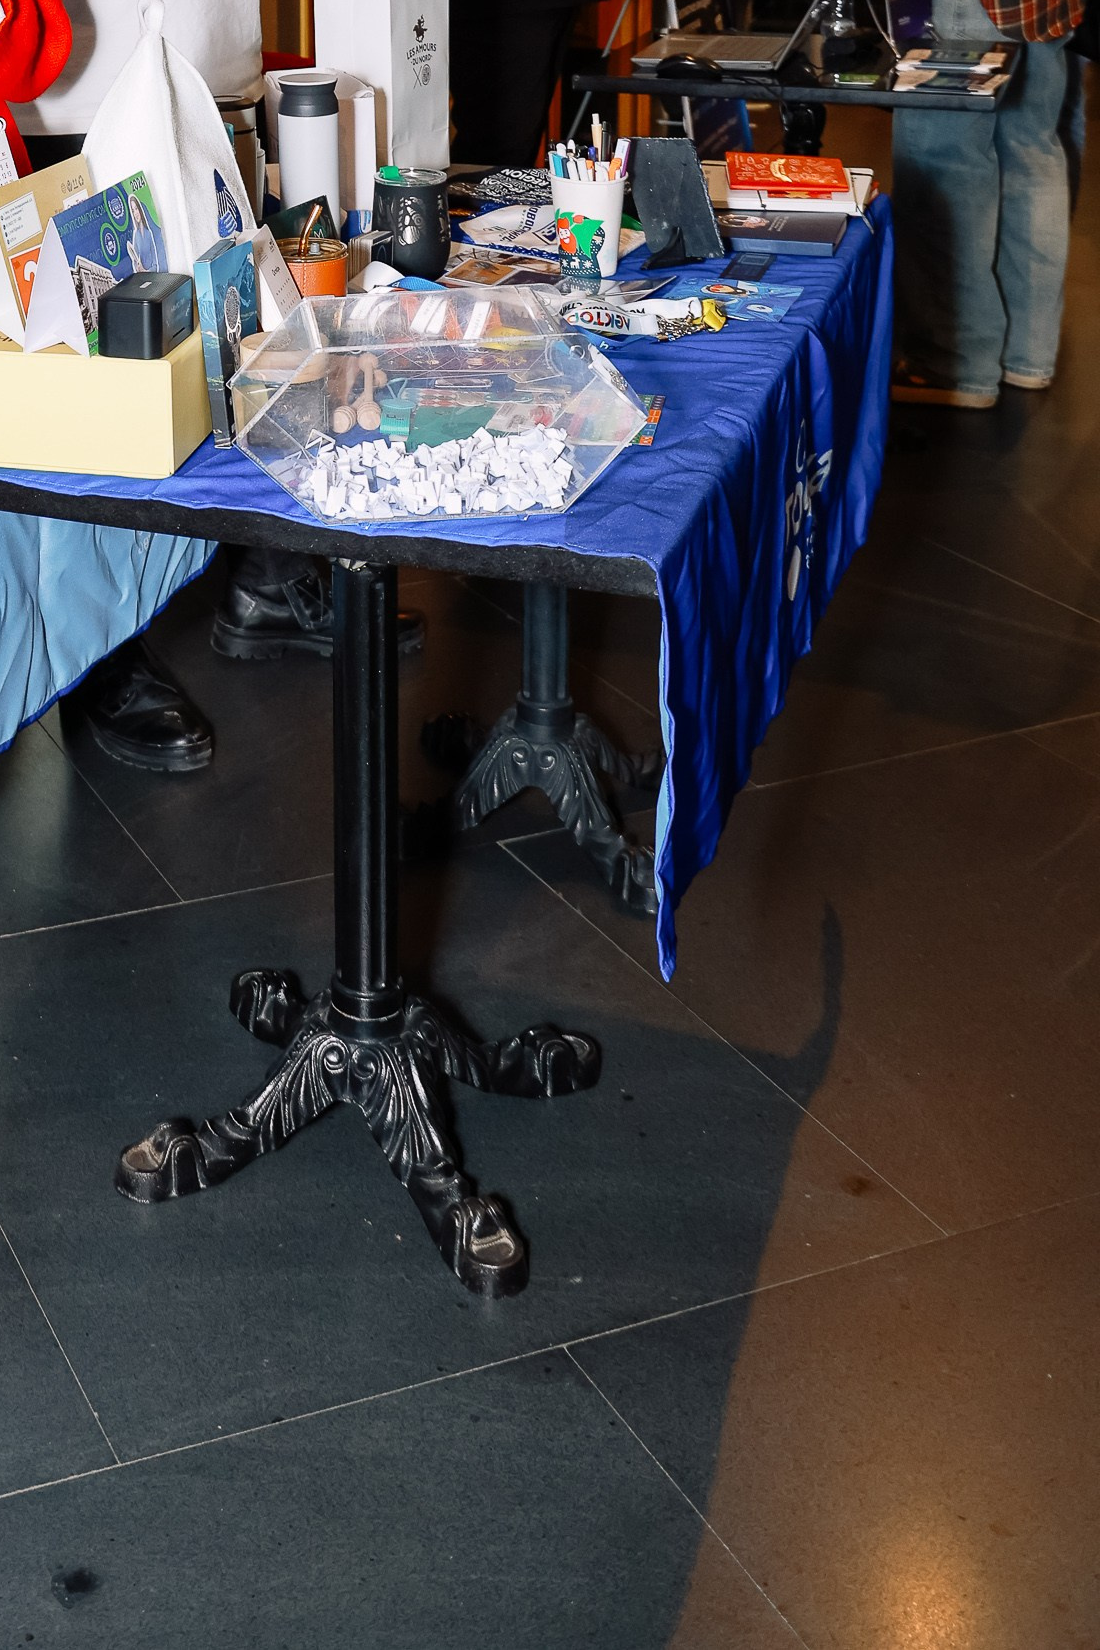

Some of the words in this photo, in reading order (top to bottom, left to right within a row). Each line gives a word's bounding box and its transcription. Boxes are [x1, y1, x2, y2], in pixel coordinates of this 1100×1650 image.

[406, 47, 416, 60] LES
[415, 43, 437, 54] AMOURS
[418, 54, 431, 63] NORD
[130, 175, 147, 193] 2024
